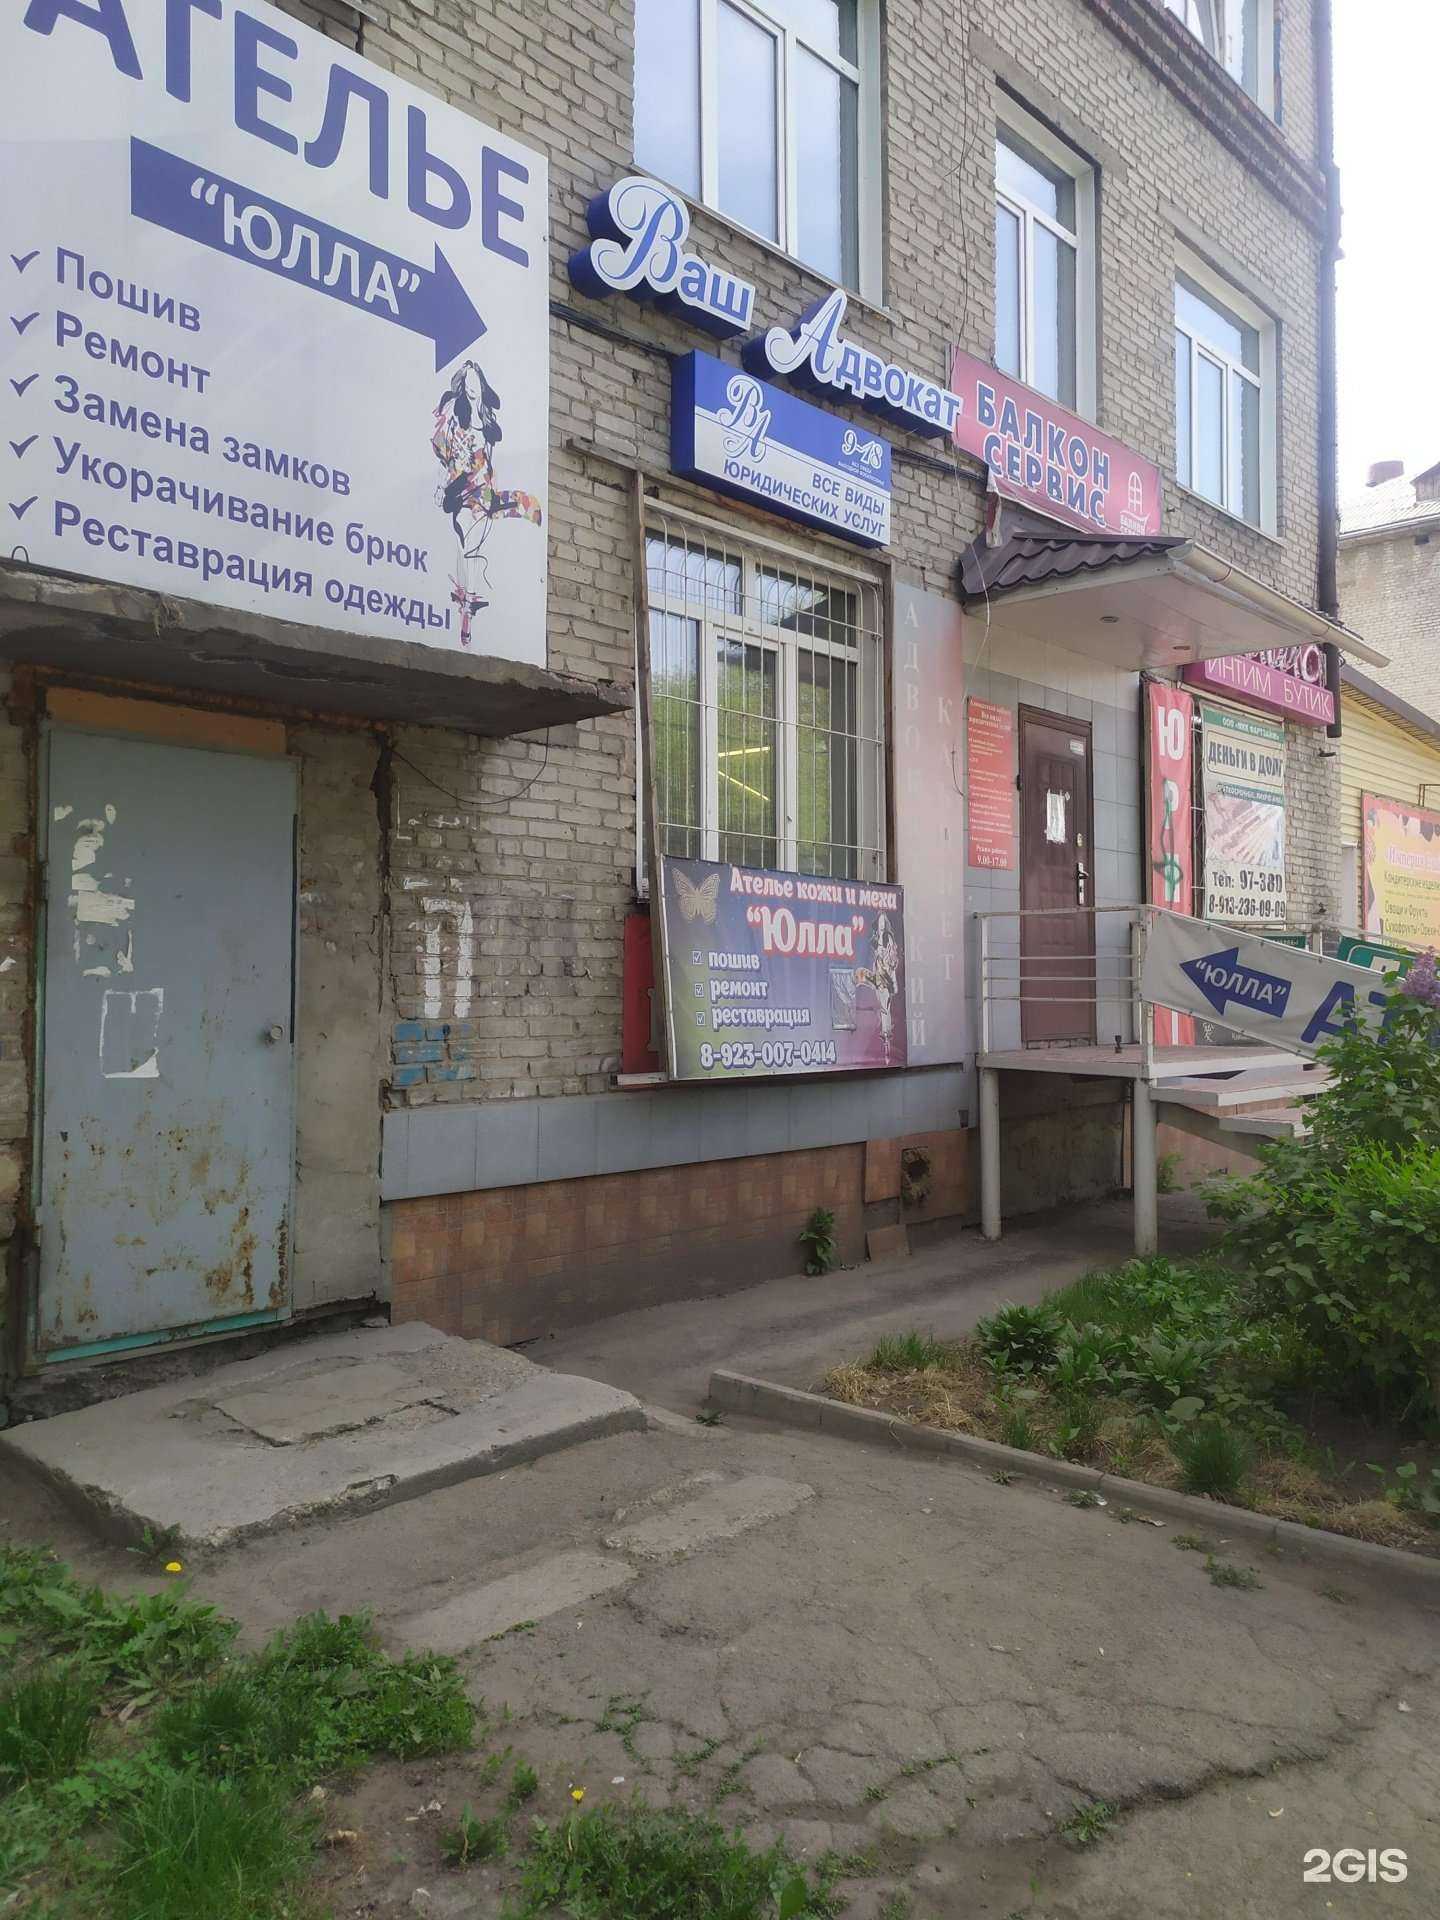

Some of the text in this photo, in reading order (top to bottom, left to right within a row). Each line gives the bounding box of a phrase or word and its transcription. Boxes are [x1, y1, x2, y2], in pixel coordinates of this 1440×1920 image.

[23, 0, 530, 269] АТЕЛЬЕ
[56, 246, 201, 332] Пошив
[592, 179, 753, 327] Ваш
[56, 310, 210, 394] Ремонт
[767, 292, 963, 430] Адвокат
[54, 375, 351, 496] Замена замков
[976, 380, 1111, 493] БАЛКОН
[53, 435, 428, 573] Укорачивание брюк
[723, 459, 840, 520] ЮРИДИЧЕСКИХ
[843, 508, 885, 539] УСЛУГ
[812, 473, 841, 499] ВСЕ
[844, 482, 885, 516] ВИДЫ
[983, 432, 1107, 528] СЕРВИС
[55, 500, 450, 630] Реставрация одежды
[1208, 656, 1272, 697] ИНТИМ
[1284, 679, 1331, 717] БУТИК
[1209, 741, 1248, 770] ДЕНЬГИ
[1250, 752, 1256, 771] В
[730, 867, 897, 909] Ателье кожи и меха
[708, 951, 760, 970] пошив
[710, 978, 768, 1004] ремонт
[700, 1040, 837, 1070] 8-923-007-0414
[711, 1006, 811, 1032] реставрация
